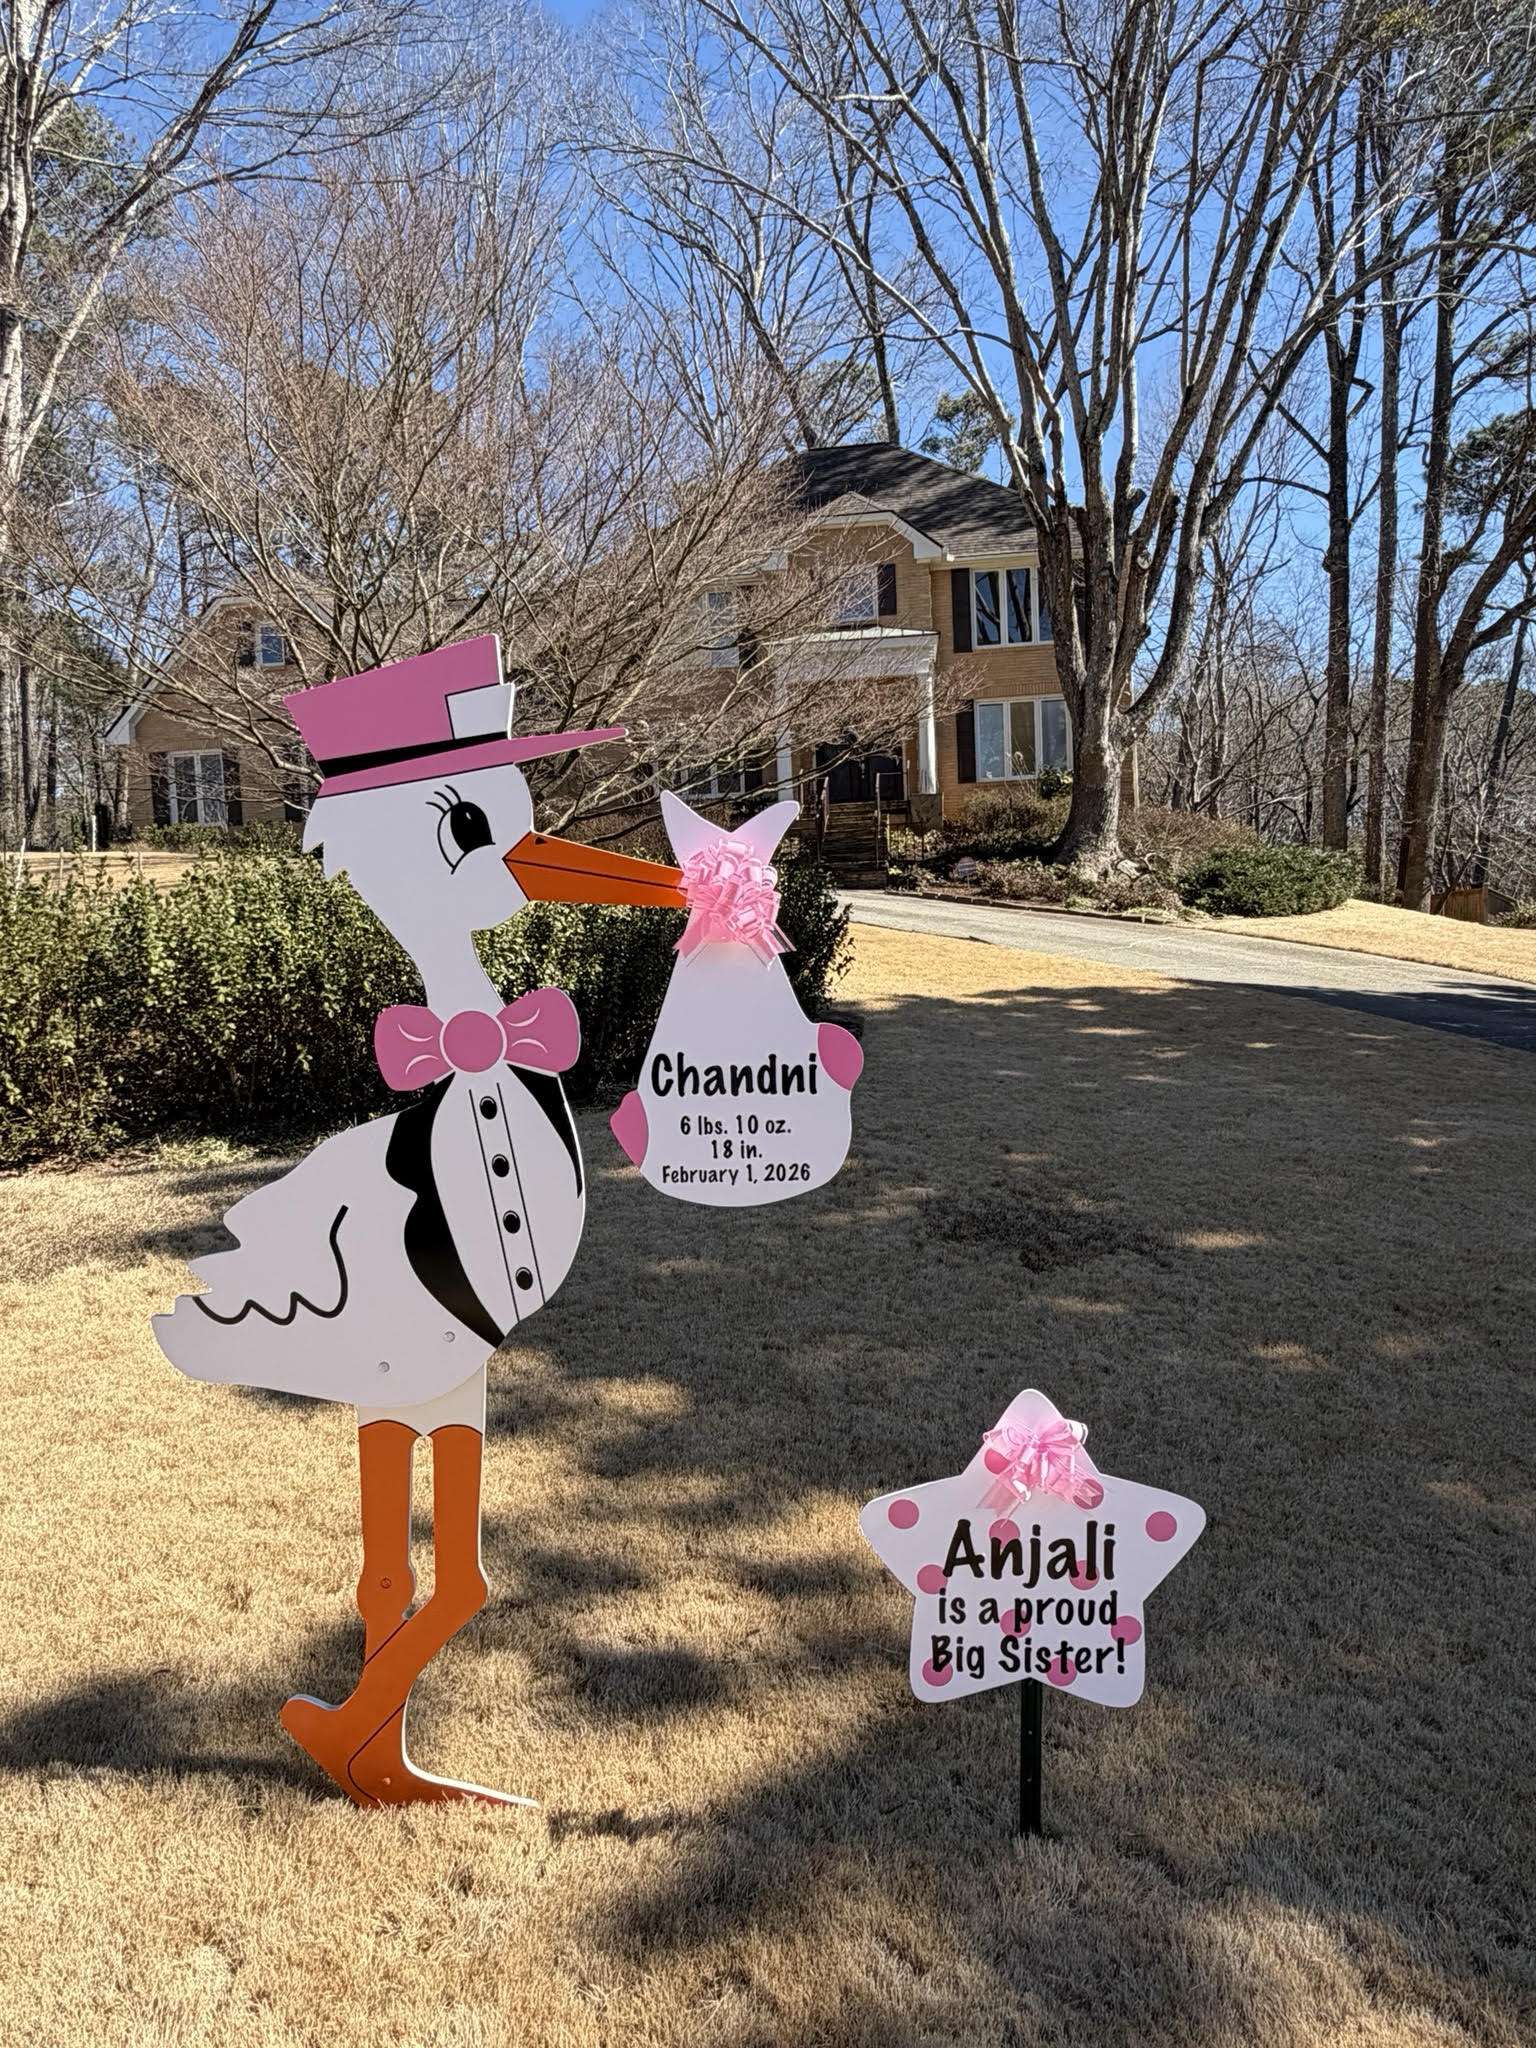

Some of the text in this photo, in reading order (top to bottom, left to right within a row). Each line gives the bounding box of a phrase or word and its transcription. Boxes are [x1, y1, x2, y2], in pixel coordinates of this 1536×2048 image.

[651, 1051, 818, 1097] Chandni
[680, 1114, 792, 1136] 6 lbs. 10 oz.
[711, 1139, 763, 1159] 18 in.
[662, 1163, 812, 1186] February 1, 2026
[942, 1519, 1116, 1589] Anjali
[938, 1587, 1118, 1634] is a proud
[931, 1634, 1126, 1680] Big Sister!
